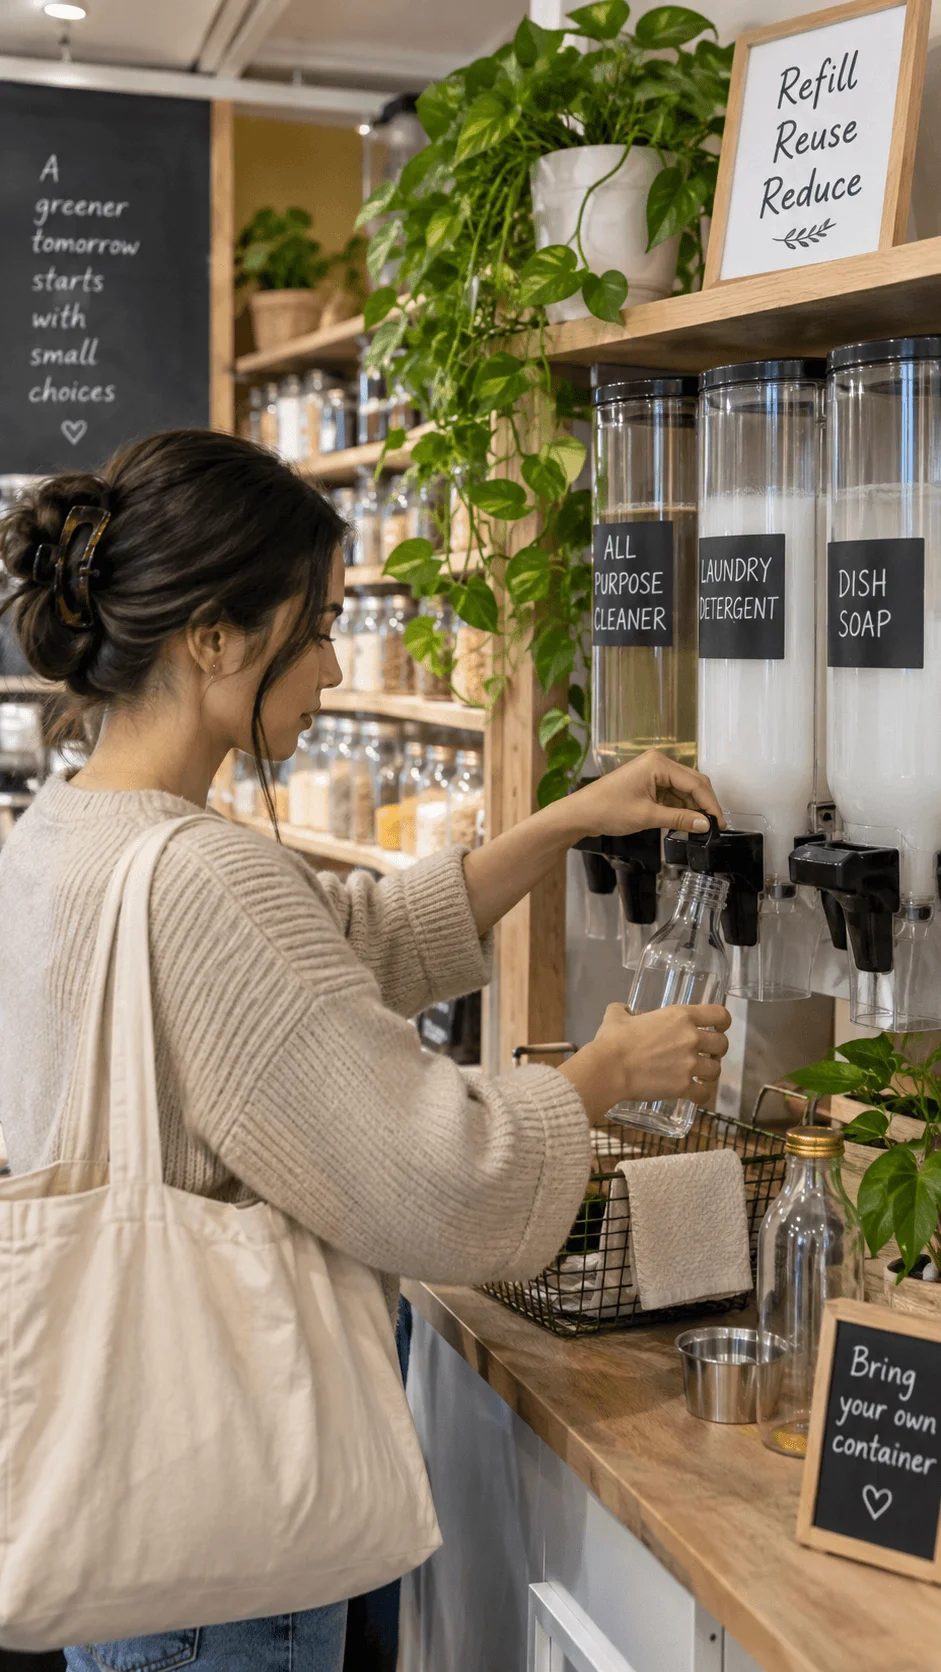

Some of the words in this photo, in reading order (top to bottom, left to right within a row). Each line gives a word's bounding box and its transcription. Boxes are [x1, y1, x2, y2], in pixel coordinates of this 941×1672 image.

[777, 50, 858, 109] Refill
[773, 120, 857, 163] Reuse
[39, 153, 59, 183] A
[759, 167, 862, 219] Reduce
[33, 198, 129, 226] greener
[32, 228, 140, 256] tomorrow
[32, 266, 104, 292] starts
[32, 302, 86, 329] with
[29, 337, 98, 366] small
[28, 376, 116, 402] choices
[604, 534, 636, 561] ALL
[594, 571, 663, 595] PURPOSE
[701, 557, 772, 583] LAUNDRY
[838, 568, 886, 598] DISH
[594, 606, 667, 631] CLEANER
[699, 596, 779, 620] DETERGENT
[838, 609, 891, 638] SOAP
[850, 1345, 916, 1401] Bring
[835, 1396, 888, 1426] your
[894, 1409, 936, 1435] own
[832, 1434, 938, 1475] container
